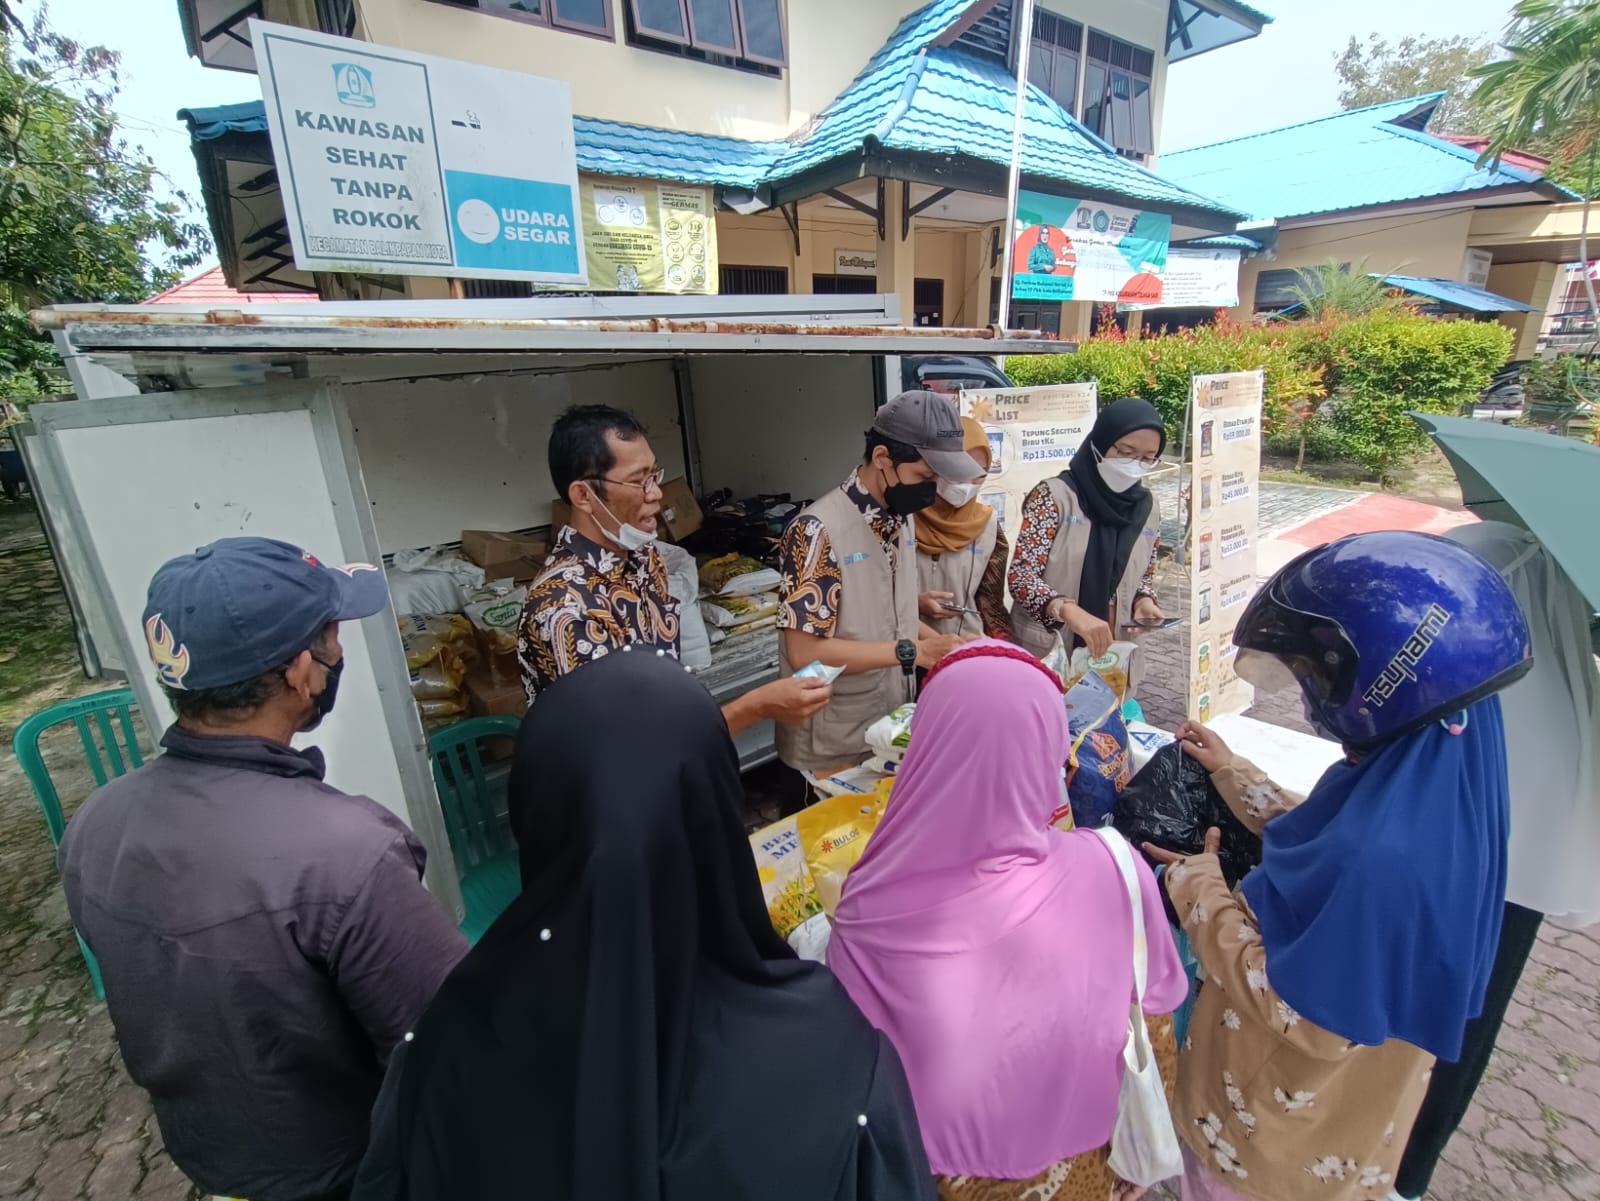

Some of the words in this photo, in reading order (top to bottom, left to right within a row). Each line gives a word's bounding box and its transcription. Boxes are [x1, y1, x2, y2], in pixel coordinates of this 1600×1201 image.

[295, 109, 425, 144] KAWASAN
[326, 146, 407, 171] SEHAT
[330, 177, 414, 201] TANPA
[333, 208, 421, 231] ROKOK
[501, 208, 569, 228] UDARA
[504, 226, 570, 245] SEGAR
[995, 393, 1031, 406] PRICE
[996, 410, 1019, 421] LIST
[1023, 447, 1077, 461] Rp13.500,00
[490, 606, 517, 625] Sania
